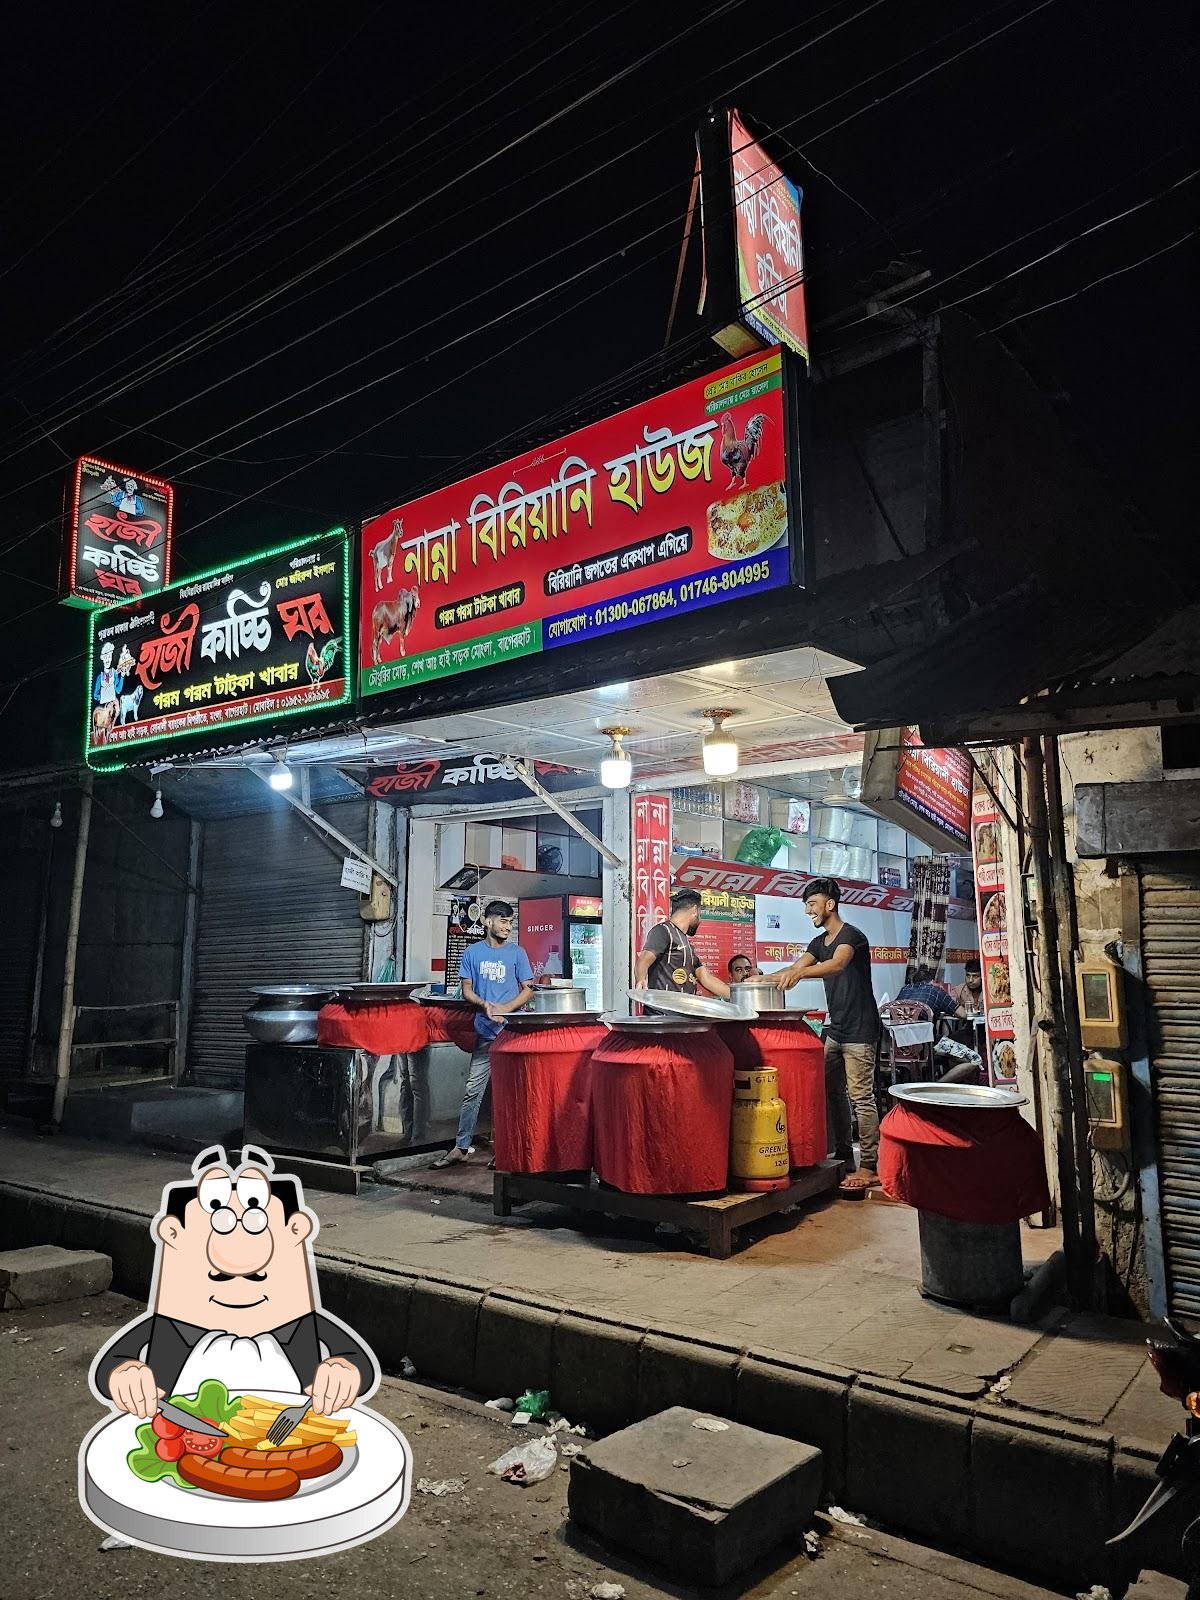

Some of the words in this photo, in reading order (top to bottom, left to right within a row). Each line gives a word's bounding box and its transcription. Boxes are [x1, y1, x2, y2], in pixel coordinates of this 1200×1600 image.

[400, 518, 461, 586] নান্না
[466, 455, 598, 566] বিরিয়ানি
[603, 425, 719, 514] হাউজ
[84, 511, 163, 549] হাজী
[82, 544, 160, 583] কাচ্চি
[95, 568, 143, 597] ঘর
[548, 565, 583, 594] বিরিয়ানি
[584, 556, 618, 582] জগতের
[620, 542, 655, 571] একধাপ
[657, 533, 688, 558] এগিয়ে
[474, 594, 498, 617] টাটকা
[499, 587, 522, 609] খাবার
[548, 614, 587, 639] যোগাযোগ
[595, 588, 678, 627] 01300-067864,
[679, 560, 770, 603] 01746-804995
[134, 602, 200, 690] হাজী
[200, 581, 273, 664] কাচ্চি
[276, 592, 334, 641] ঘর
[153, 688, 181, 711] গরম
[184, 681, 212, 706] গরম
[258, 661, 300, 687] খাবার
[366, 758, 441, 797] হাজী
[679, 865, 764, 892] নান্না
[527, 924, 554, 933] SINGER
[758, 1145, 781, 1154] GREEN
